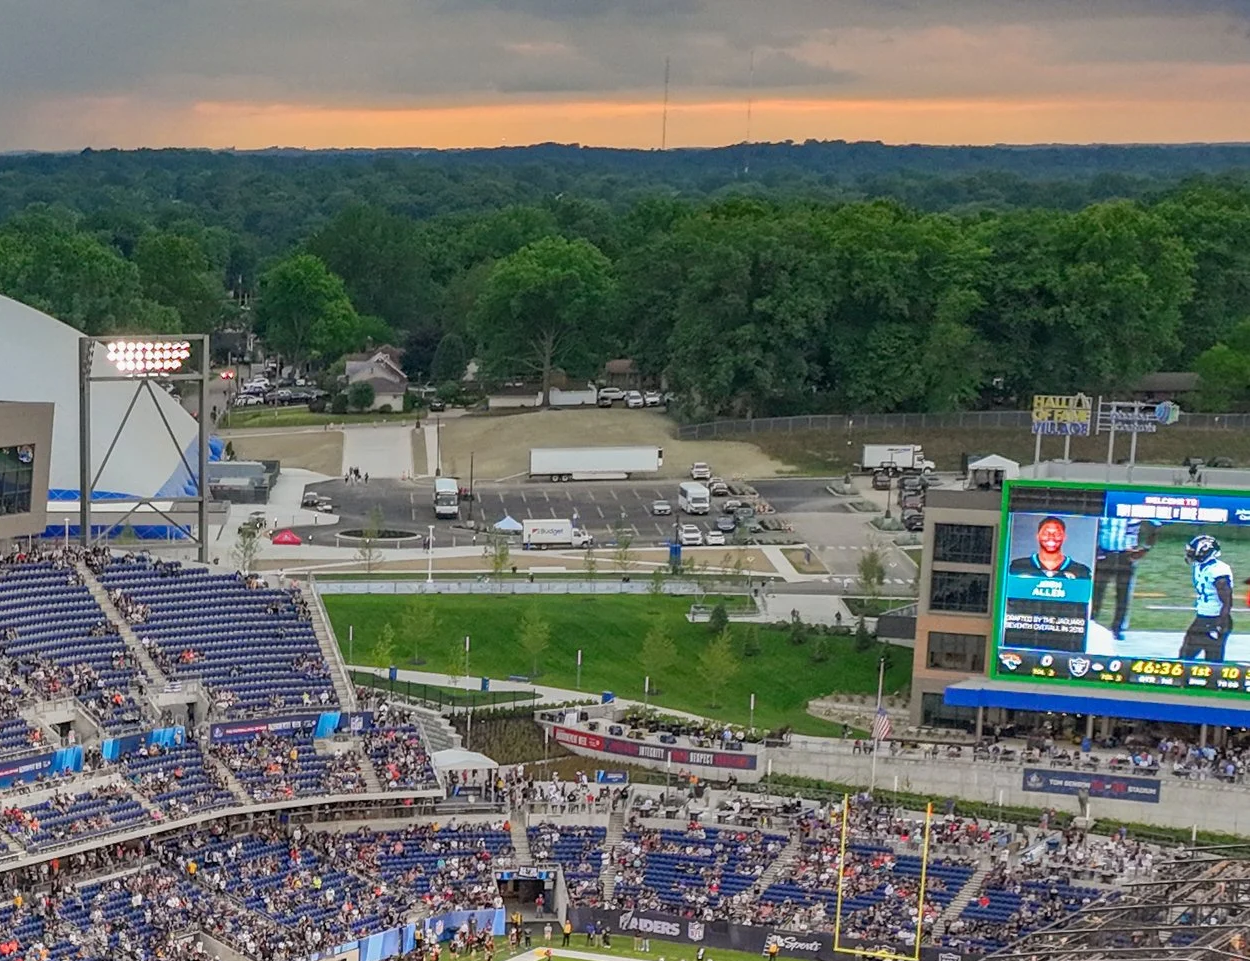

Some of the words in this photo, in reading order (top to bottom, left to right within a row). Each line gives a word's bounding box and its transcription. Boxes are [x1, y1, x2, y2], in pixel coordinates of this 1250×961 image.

[1032, 588, 1065, 597] ALLEN
[1132, 660, 1184, 676] 46:36
[1190, 666, 1211, 676] 1st
[1222, 667, 1240, 679] 10
[690, 753, 714, 764] RESPECT
[619, 910, 681, 937] RAIDERS
